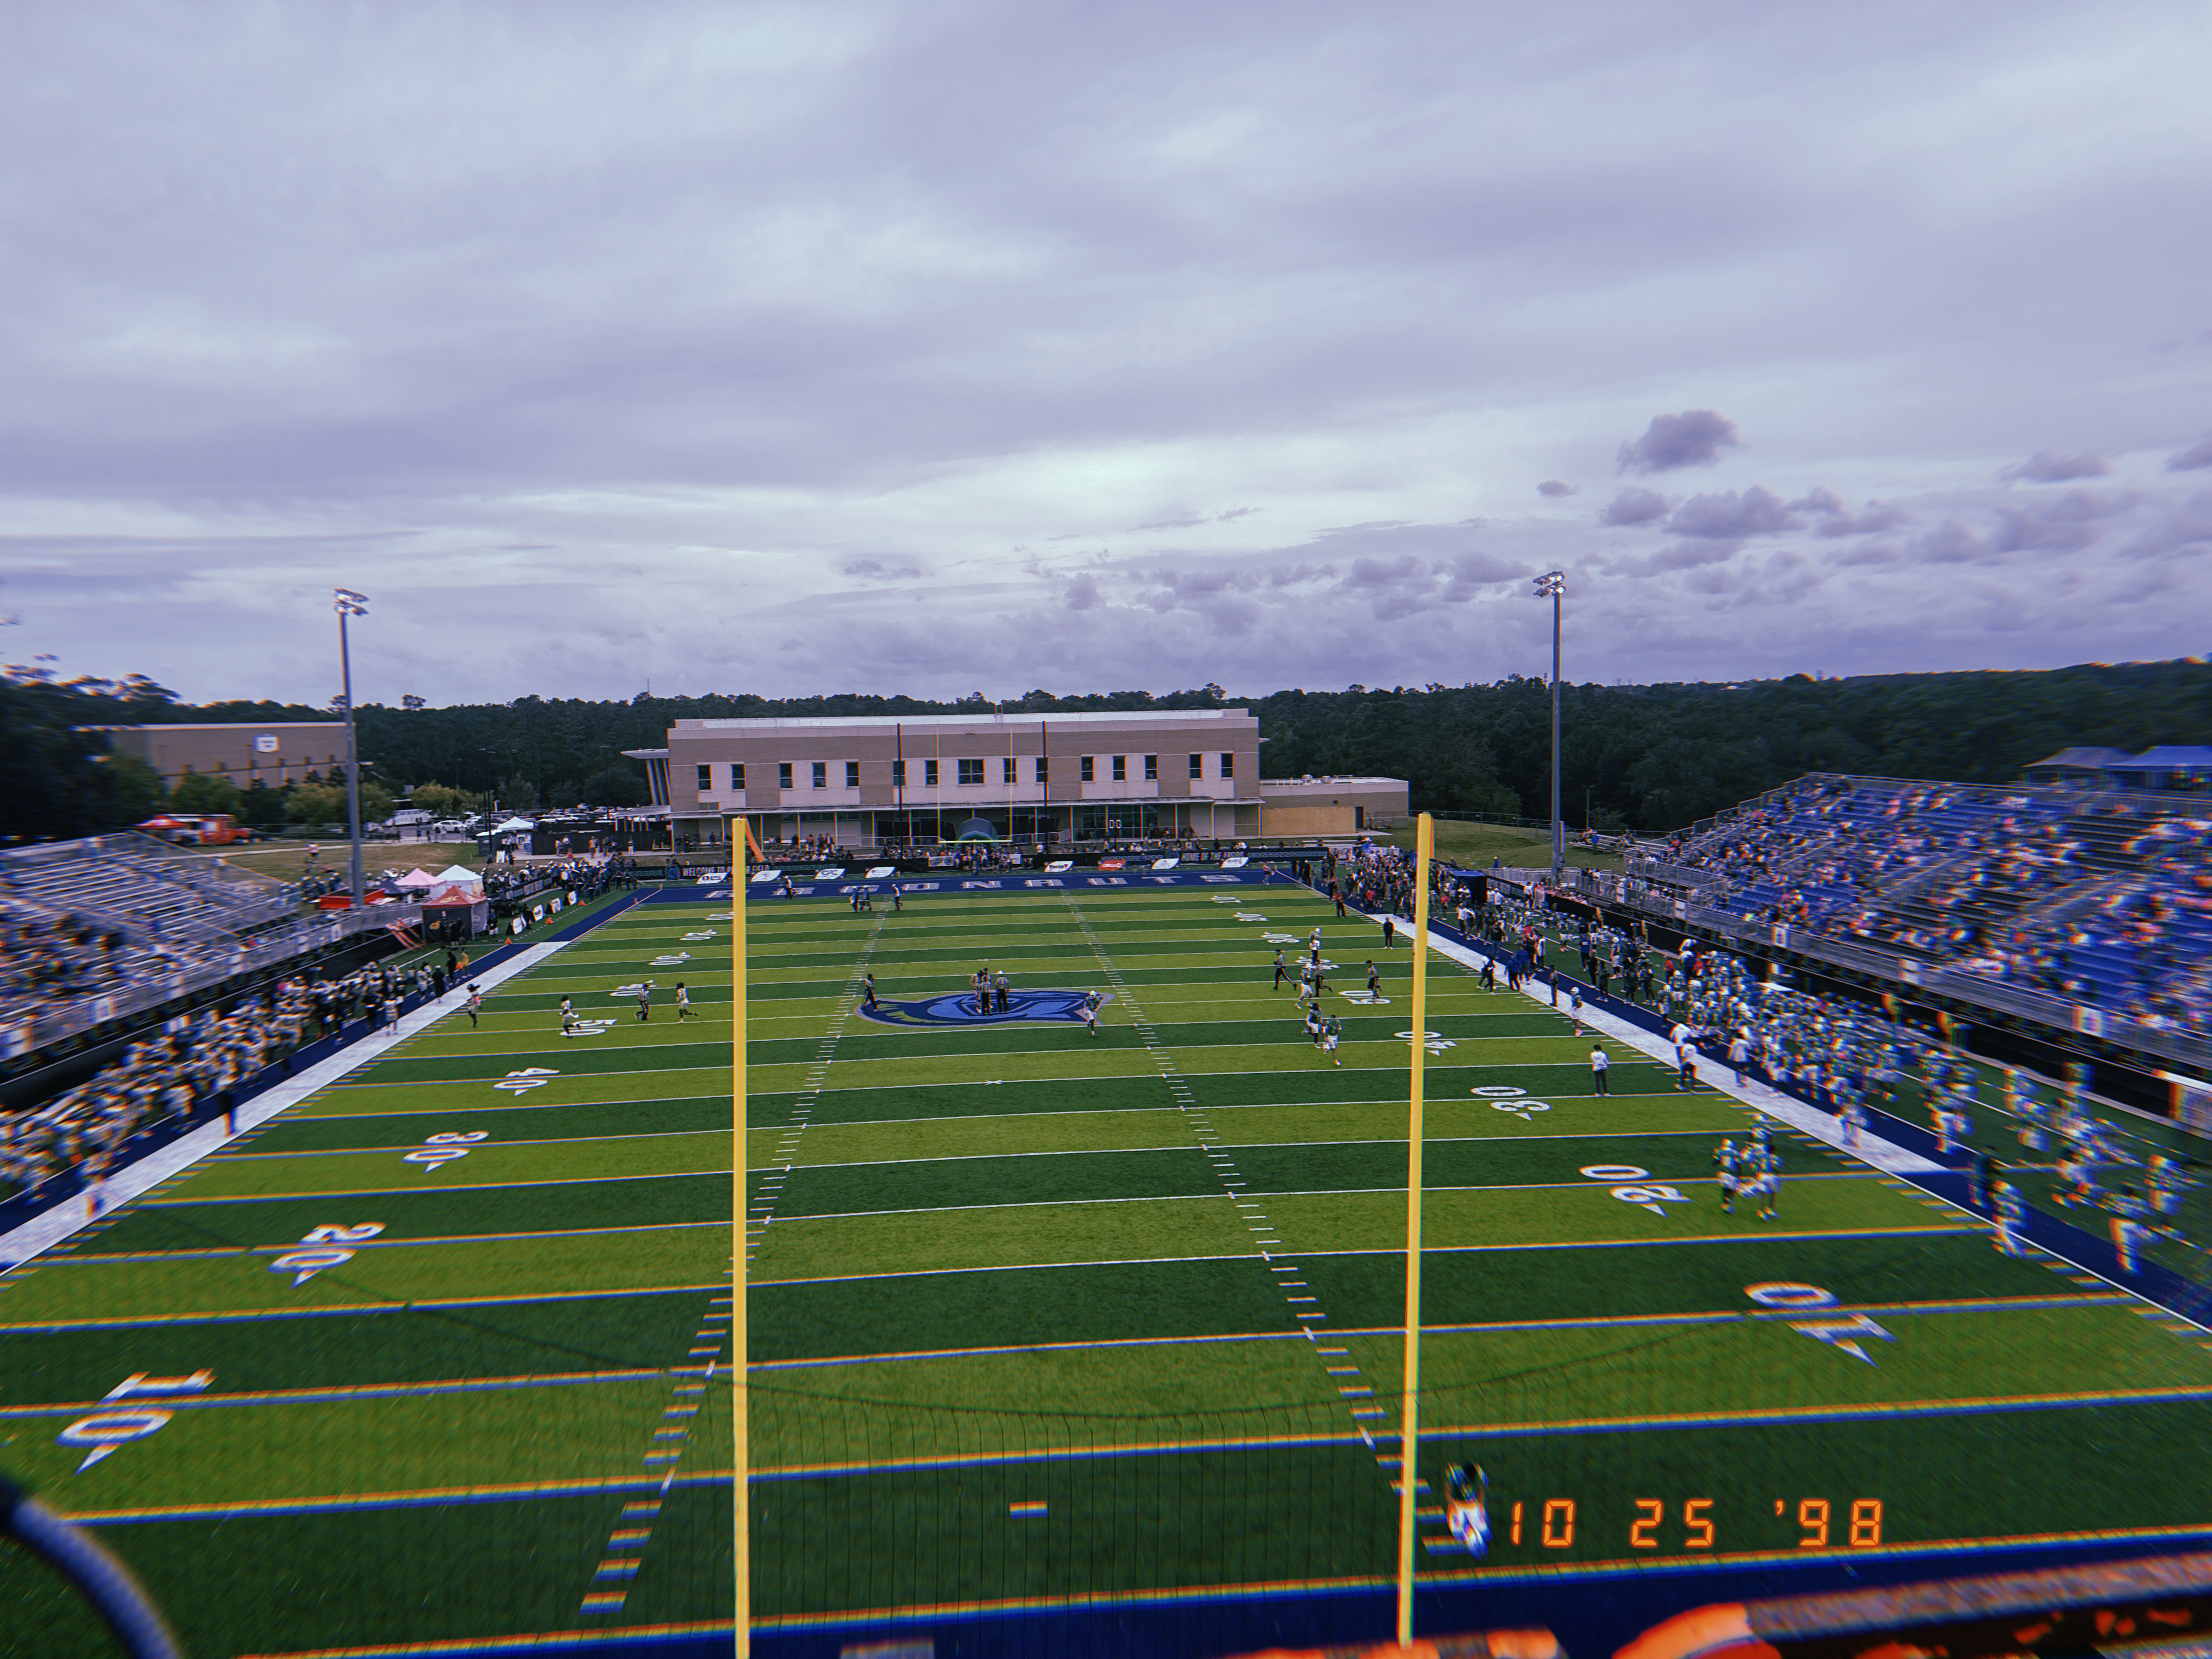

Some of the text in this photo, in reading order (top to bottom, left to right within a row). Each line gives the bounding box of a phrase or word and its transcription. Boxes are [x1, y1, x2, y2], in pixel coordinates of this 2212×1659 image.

[1109, 819, 1123, 829] 00
[1181, 853, 1200, 861] HOME
[1201, 852, 1210, 861] OF
[1210, 851, 1222, 861] THE
[682, 866, 717, 877] WELCOME
[1260, 934, 1301, 944] 30
[647, 955, 692, 966] 30
[1338, 990, 1392, 1005] 50
[558, 1018, 619, 1036] 50
[493, 1067, 560, 1090] 40
[1470, 1086, 1551, 1112] 30
[400, 1130, 490, 1164] 30
[1578, 1164, 1695, 1204] 20
[266, 1221, 387, 1274] 20
[1742, 1281, 1899, 1346] 10
[54, 1368, 218, 1448] 10
